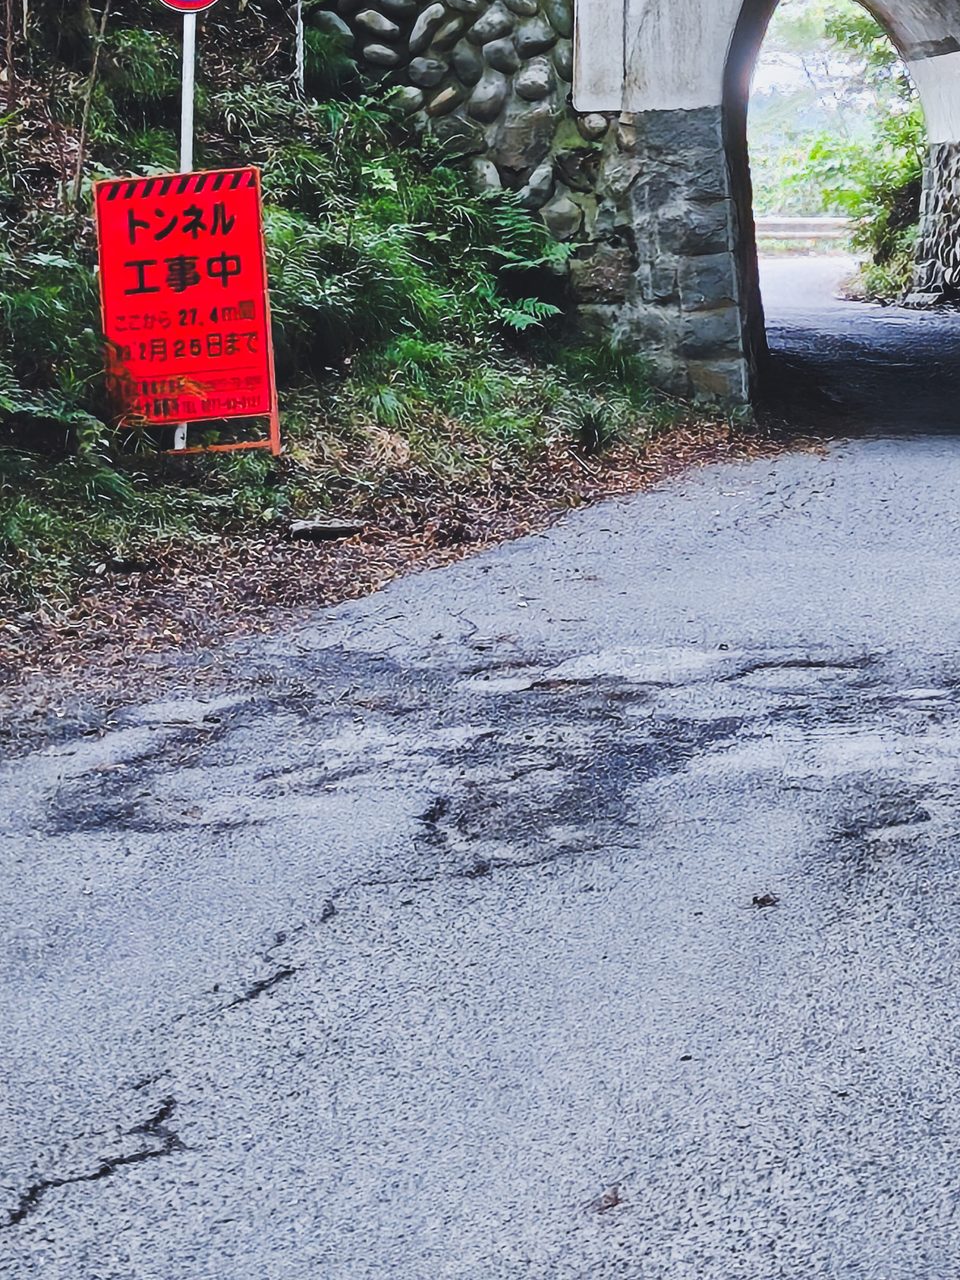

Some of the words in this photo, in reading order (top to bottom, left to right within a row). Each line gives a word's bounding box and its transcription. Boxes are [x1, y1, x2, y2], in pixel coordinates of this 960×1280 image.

[127, 201, 235, 245] トンネル
[124, 251, 241, 295] 工事中
